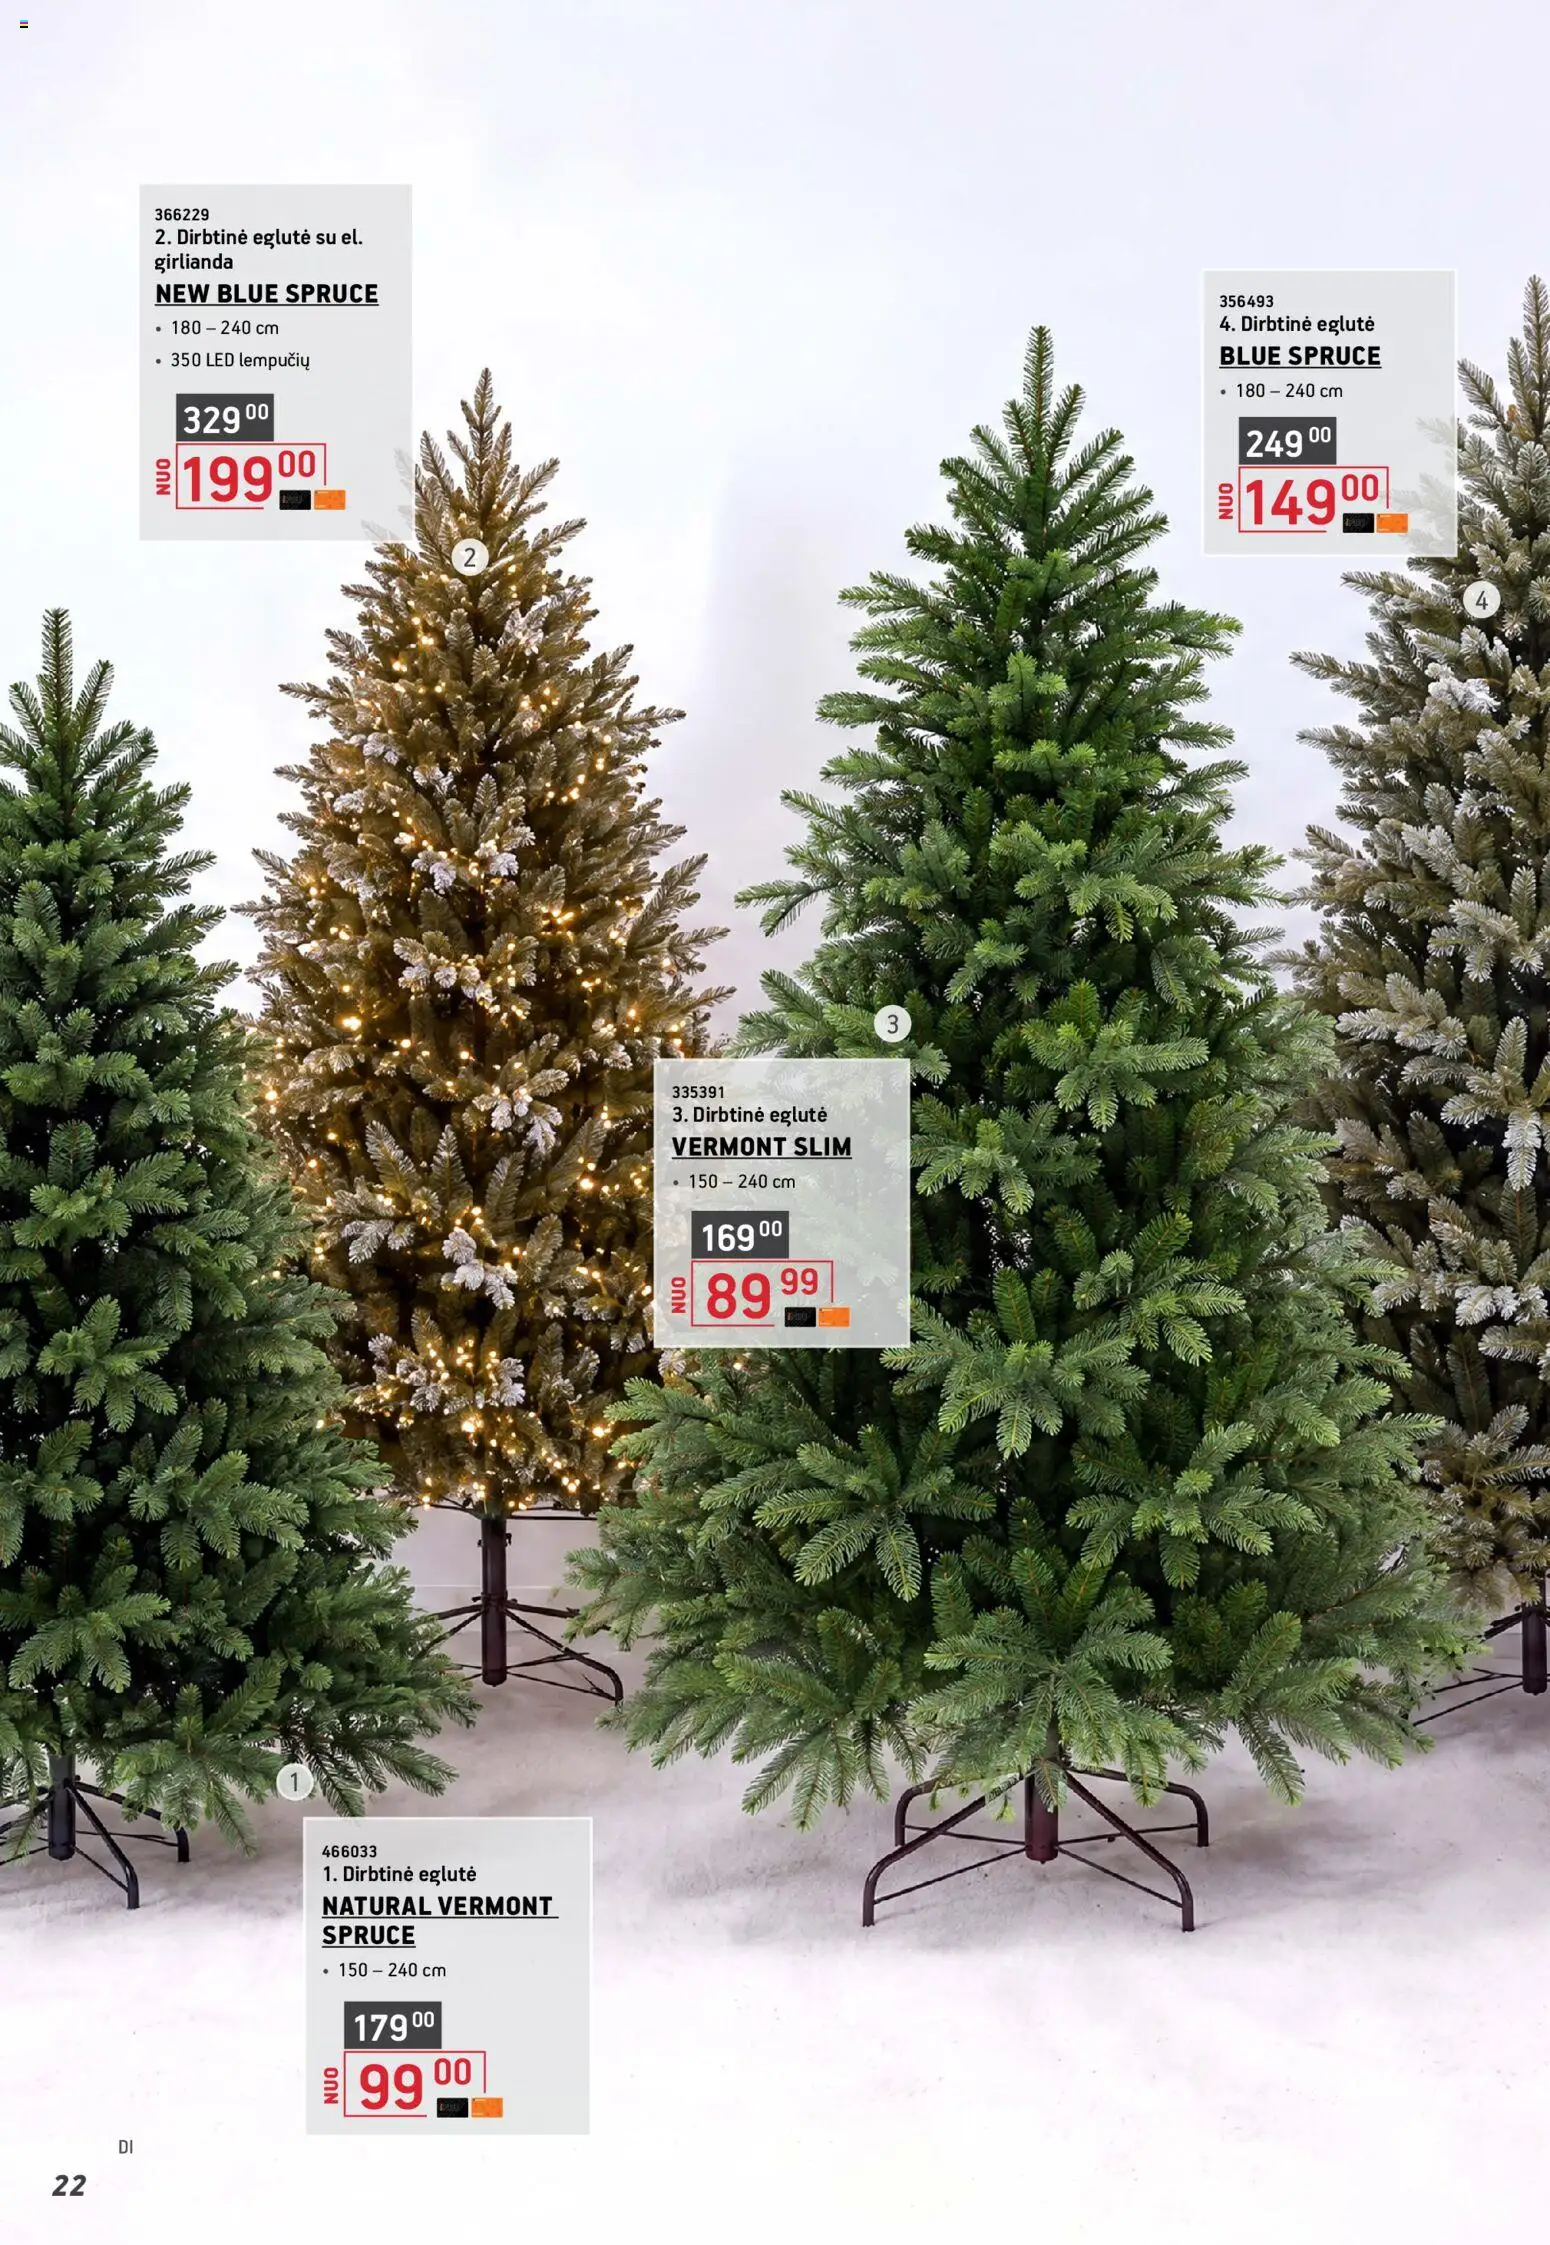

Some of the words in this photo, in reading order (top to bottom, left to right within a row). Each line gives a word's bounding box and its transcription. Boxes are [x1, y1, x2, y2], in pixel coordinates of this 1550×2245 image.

[154, 208, 210, 222] 366229
[154, 229, 172, 245] 2.
[176, 228, 248, 245] Dirbtinė
[252, 228, 311, 249] eglutė
[315, 232, 337, 245] su
[341, 228, 363, 245] el.
[154, 253, 234, 274] girlianda
[156, 283, 210, 304] NEW
[217, 283, 278, 304] BLUE
[286, 283, 379, 304] SPRUCE
[1219, 295, 1274, 308] 356493
[171, 320, 201, 335] 180
[220, 320, 251, 335] 240
[255, 324, 279, 335] cm
[1219, 316, 1236, 332] 4.
[1241, 315, 1312, 332] Dirbtinė
[1317, 315, 1375, 336] eglutė
[171, 353, 201, 367] 350
[206, 353, 235, 367] LED
[238, 352, 310, 371] lempučių
[1220, 346, 1281, 365] BLUE
[1288, 346, 1381, 365] SPRUCE
[1236, 383, 1265, 398] 180
[1285, 383, 1315, 398] 240
[1319, 386, 1343, 398] cm
[183, 405, 241, 435] 329
[245, 403, 269, 420] 00
[1246, 429, 1303, 458] 249
[1308, 426, 1331, 443] 00
[156, 458, 171, 496] NUO
[183, 455, 273, 503] 199
[278, 450, 316, 478] 00
[1218, 482, 1234, 520] NUO
[1246, 478, 1336, 526] 149
[1341, 473, 1379, 501] 00
[463, 547, 476, 568] 2
[1475, 590, 1489, 610] 4
[887, 1014, 899, 1035] 3
[672, 1085, 725, 1099] 335391
[672, 1107, 688, 1123] 3.
[693, 1106, 765, 1123] Dirbtinė
[770, 1106, 828, 1127] eglutė
[671, 1136, 787, 1157] VERMONT
[794, 1136, 851, 1157] SLIM
[689, 1174, 718, 1189] 150
[738, 1174, 768, 1189] 240
[772, 1177, 796, 1189] cm
[702, 1223, 755, 1252] 169
[759, 1220, 782, 1237] 00
[671, 1276, 686, 1314] NUO
[706, 1272, 771, 1320] 89
[780, 1267, 819, 1296] 99
[290, 1772, 298, 1792] 1
[321, 1845, 377, 1859] 466033
[323, 1866, 338, 1882] 1.
[343, 1865, 414, 1882] Dirbtinė
[419, 1865, 477, 1886] eglutė
[322, 1896, 432, 1916] NATURAL
[438, 1896, 553, 1916] VERMONT
[322, 1925, 416, 1945] SPRUCE
[339, 1962, 368, 1978] 150
[388, 1962, 418, 1978] 240
[422, 1966, 446, 1978] cm
[354, 2013, 408, 2042] 179
[412, 2011, 435, 2028] 00
[323, 2067, 339, 2104] NUO
[359, 2063, 423, 2111] 99
[434, 2057, 472, 2086] 00
[118, 2139, 133, 2154] DI
[51, 2174, 87, 2197] 22
